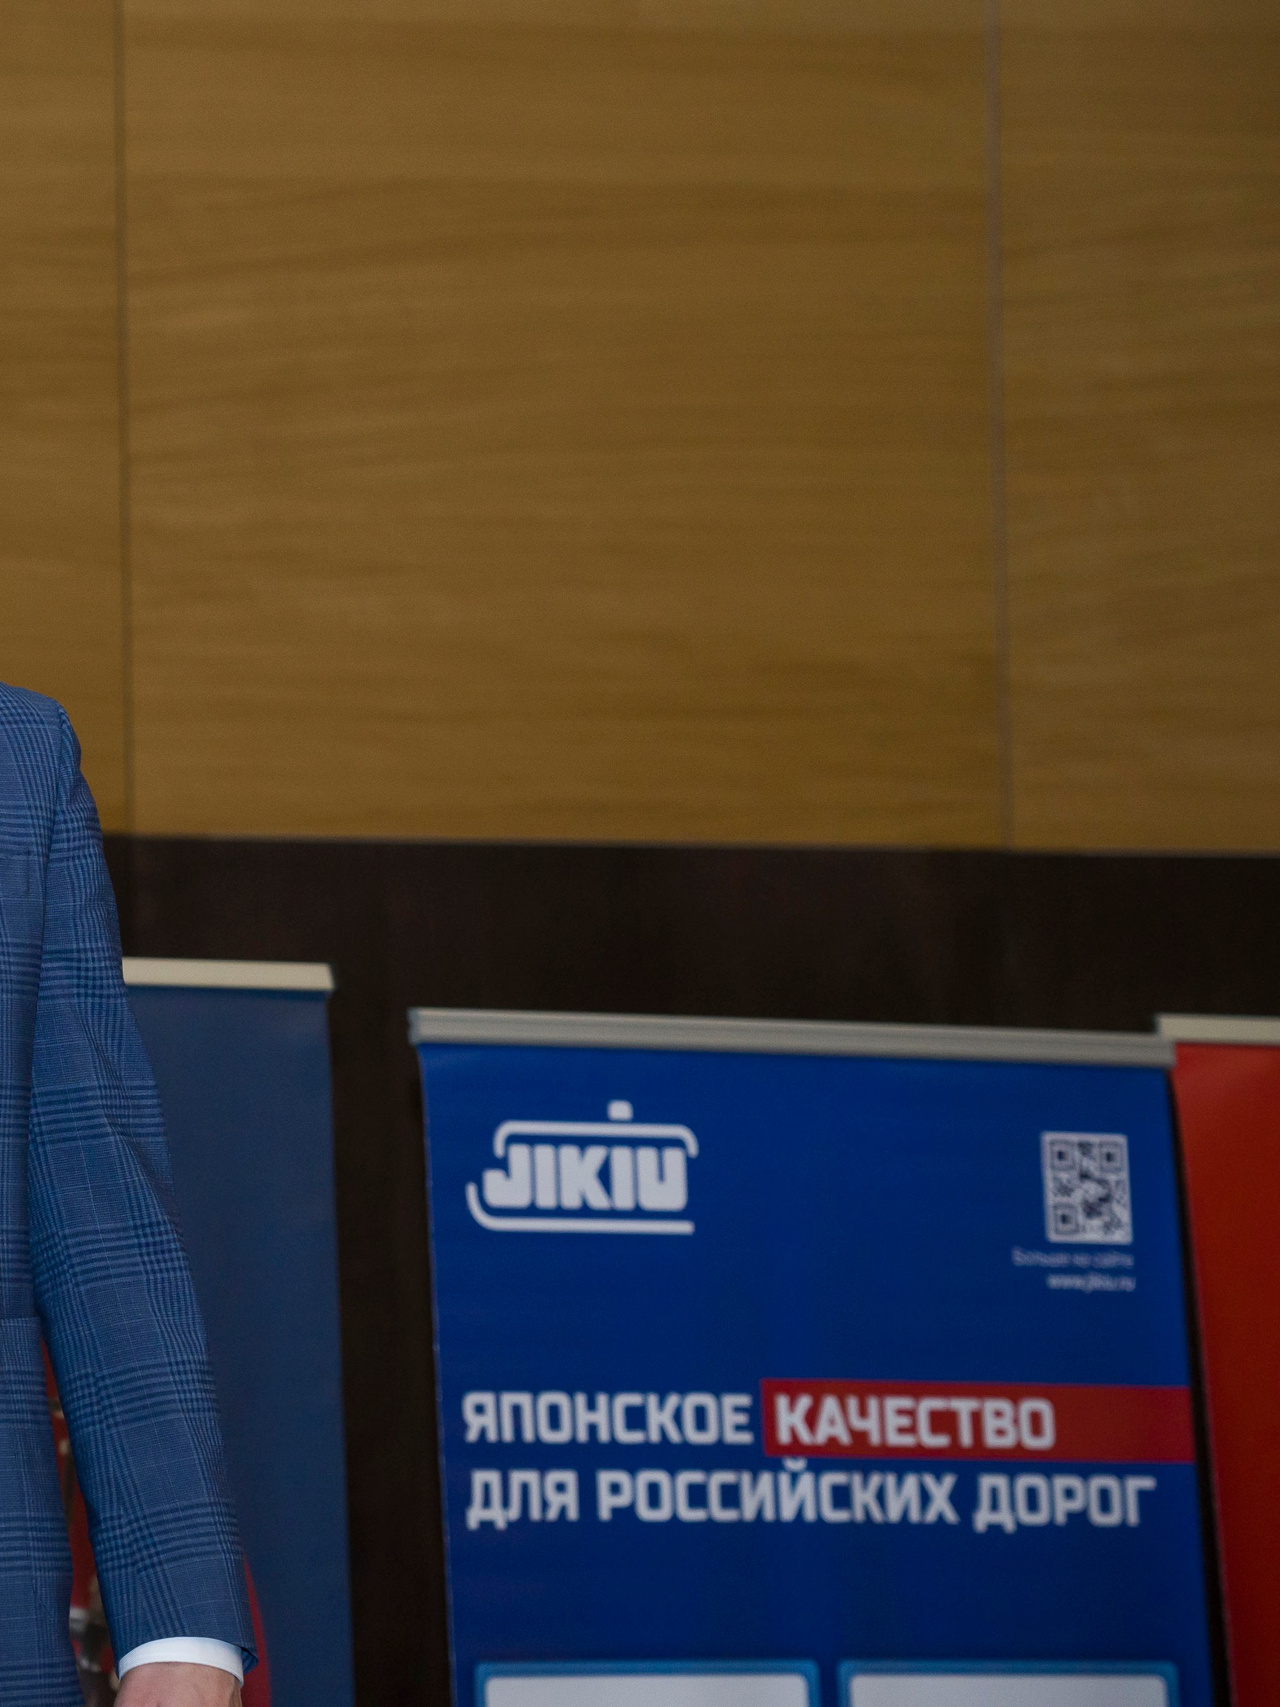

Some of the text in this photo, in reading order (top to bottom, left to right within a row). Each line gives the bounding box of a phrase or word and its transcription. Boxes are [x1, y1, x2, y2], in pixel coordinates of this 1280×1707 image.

[482, 1142, 688, 1212] JIKIU
[463, 1391, 1056, 1450] ЯПОНСКОЕ КАЧЕСТВО
[466, 1456, 1157, 1534] ДЛЯ РОССИЙСКИХ ДОРОГ
